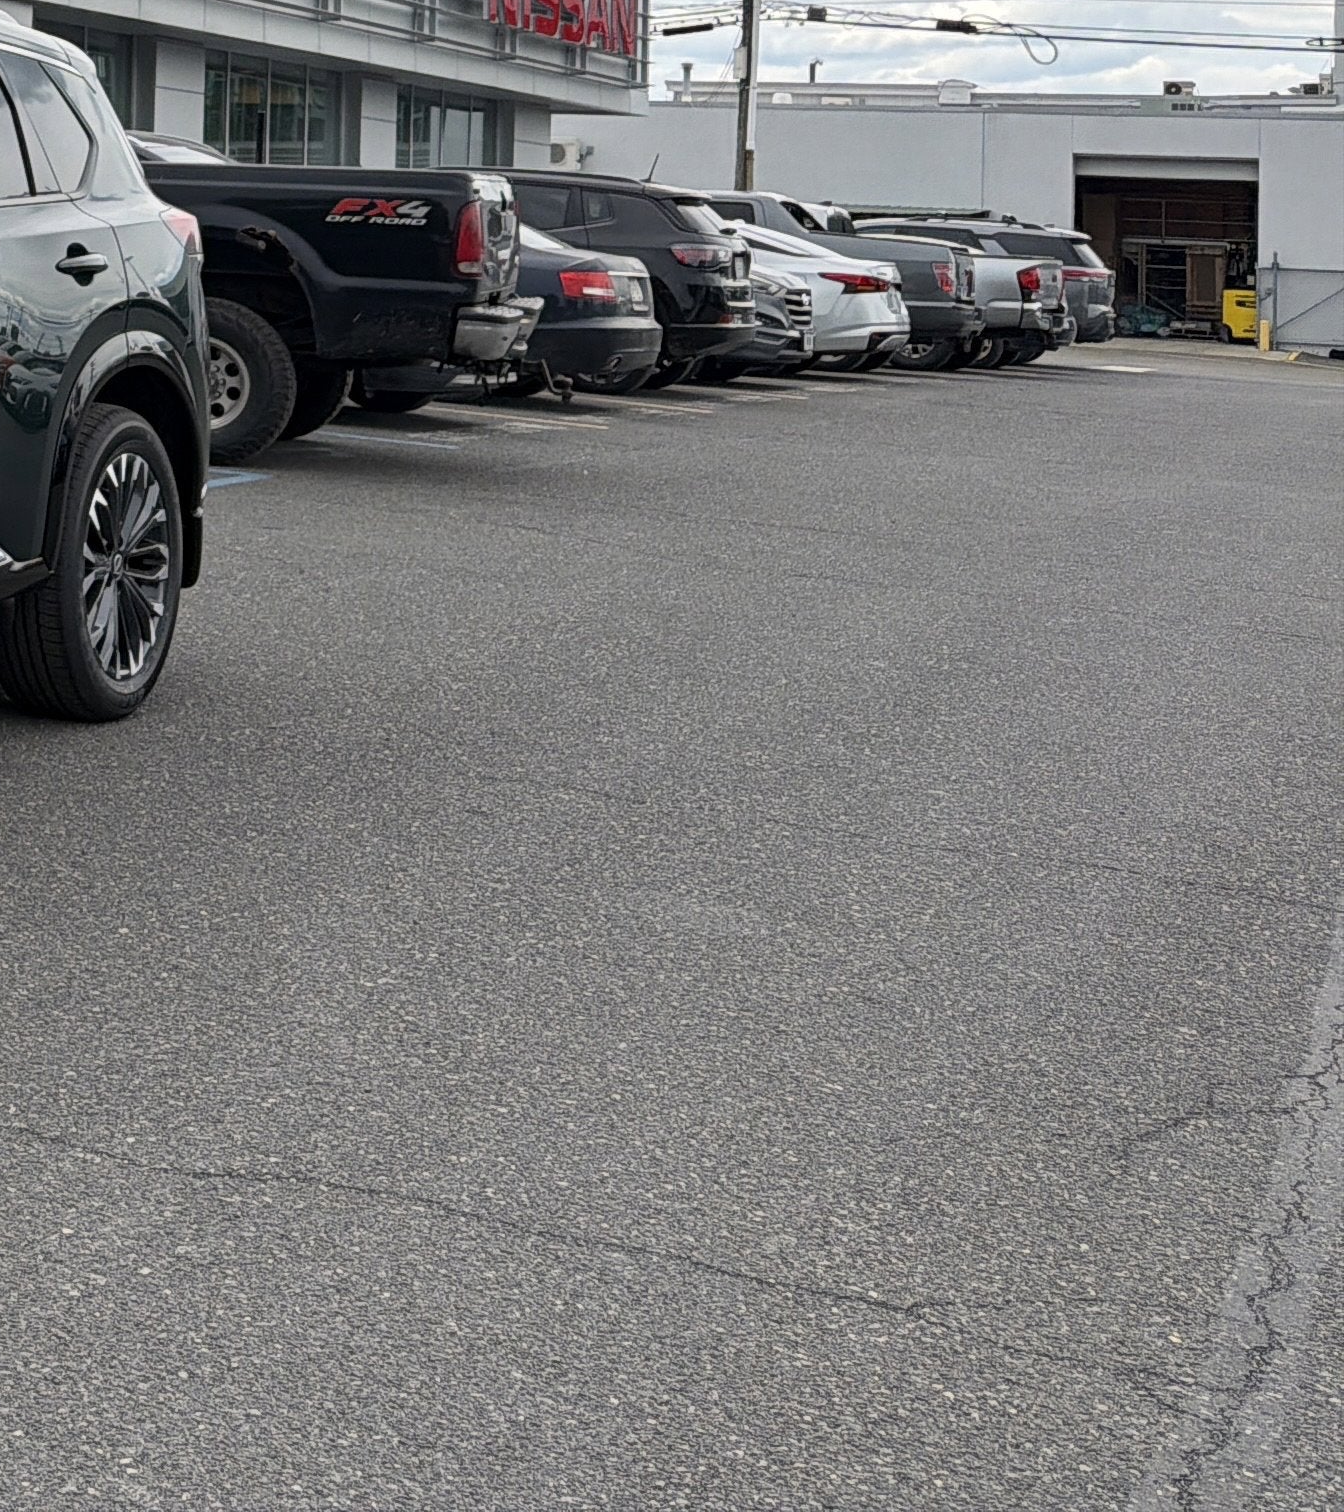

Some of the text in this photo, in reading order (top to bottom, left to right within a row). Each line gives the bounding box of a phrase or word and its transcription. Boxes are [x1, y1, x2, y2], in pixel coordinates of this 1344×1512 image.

[330, 198, 432, 218] FX4
[324, 214, 428, 226] OFF ROAD
